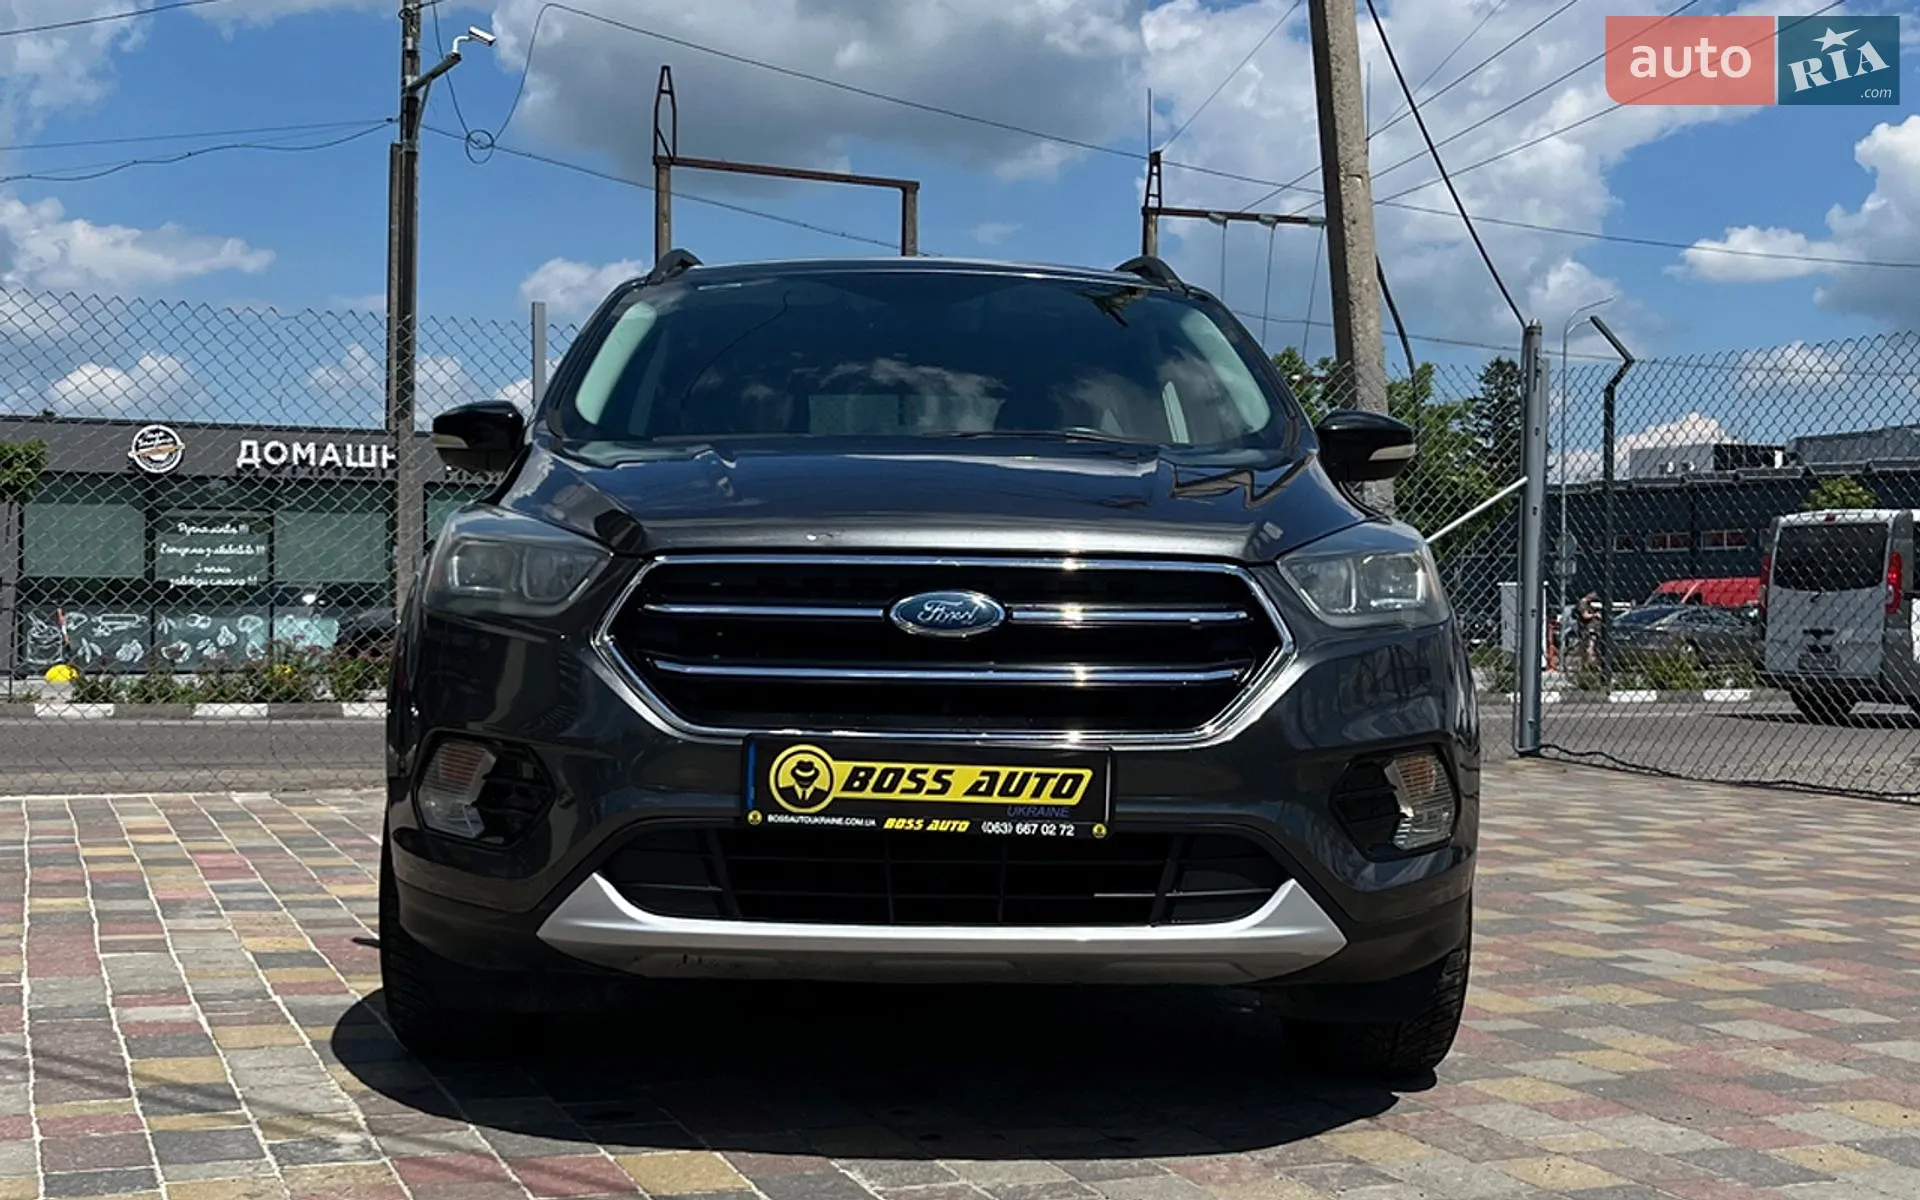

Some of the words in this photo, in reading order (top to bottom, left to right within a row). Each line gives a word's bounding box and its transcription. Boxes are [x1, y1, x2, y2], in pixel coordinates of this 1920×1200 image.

[917, 599, 980, 625] Ford
[841, 765, 953, 796] BOSS
[962, 769, 1087, 799] AUTO
[1006, 805, 1070, 818] UKRAINE
[883, 817, 924, 830] BOSS
[926, 819, 970, 833] AUTO
[981, 821, 1013, 835] (063)
[1015, 822, 1036, 835] 667
[1040, 823, 1057, 836] 02
[1059, 823, 1076, 837] 72
